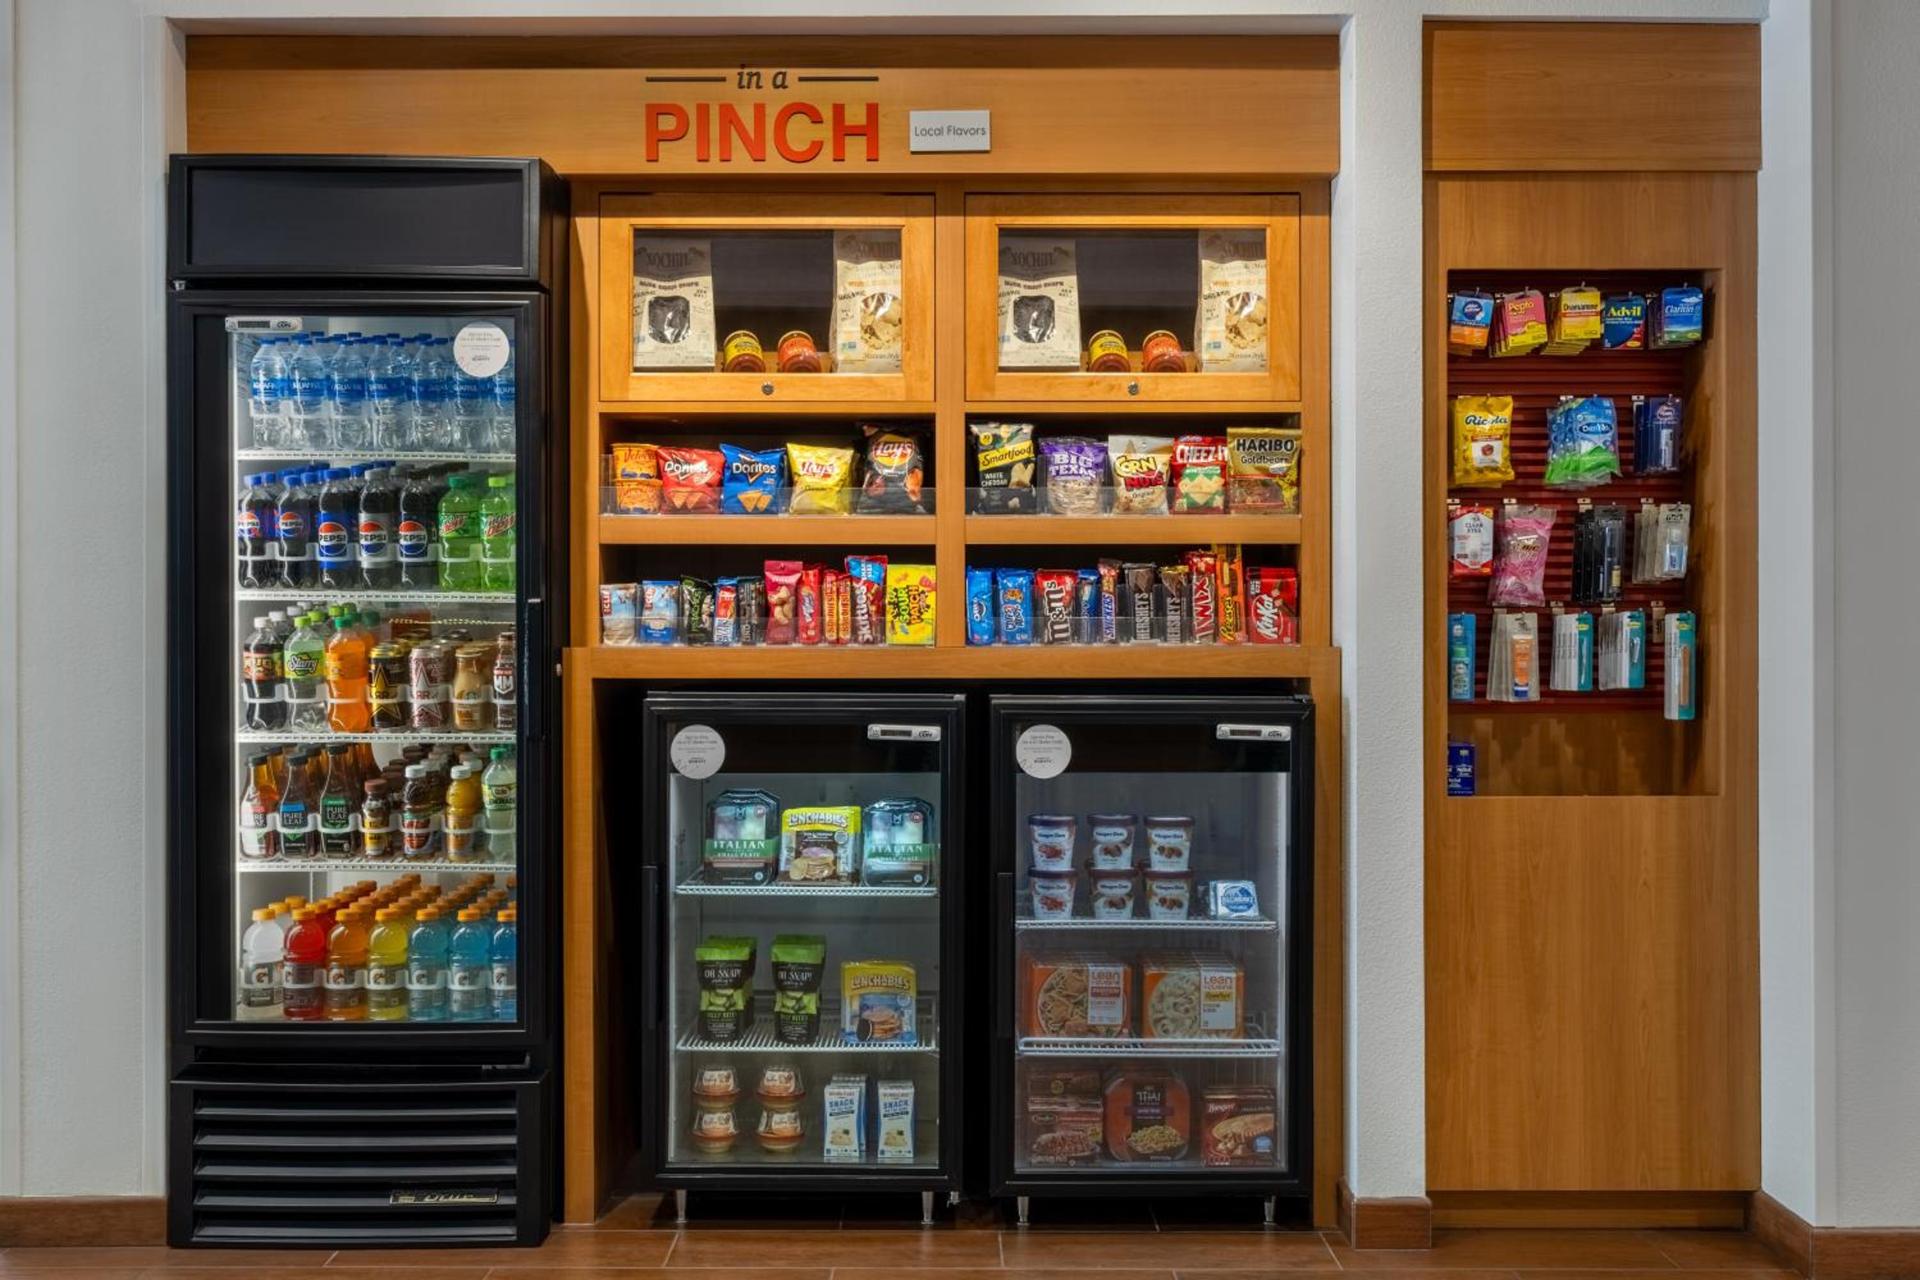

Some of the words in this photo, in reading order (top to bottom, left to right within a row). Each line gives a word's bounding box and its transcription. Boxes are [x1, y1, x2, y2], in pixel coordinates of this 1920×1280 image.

[737, 64, 763, 89] in
[772, 70, 788, 89] a
[645, 102, 879, 163] PINCH
[914, 125, 944, 138] Local
[946, 125, 987, 137] Flavors
[1509, 301, 1535, 313] Pepto
[1607, 306, 1641, 317] Advil
[1465, 415, 1510, 426] Ricola
[1236, 439, 1295, 452] HARIBO
[981, 446, 1032, 466] Smartfood
[1054, 452, 1094, 468] BIG
[1240, 455, 1290, 465] Goldbears
[732, 462, 777, 474] Doritos
[1049, 465, 1097, 479] TEXAS
[1114, 455, 1158, 476] CORN
[319, 533, 347, 542] PEPSI
[360, 533, 386, 542] PEPSI
[898, 588, 909, 623] SOUR
[909, 585, 921, 624] PATCH
[1195, 576, 1214, 638] TWIX
[855, 585, 873, 642] Skittles
[1103, 595, 1116, 638] SNICKERS
[1135, 592, 1149, 640] HERSHEY'S
[290, 656, 317, 671] Starry
[788, 811, 847, 827] LUNCHABLES
[714, 840, 766, 849] ITALIAN
[871, 845, 923, 853] ITALIAN
[704, 969, 715, 978] OH
[1202, 975, 1232, 985] Lean
[851, 975, 912, 990] LUNCHABLES
[1137, 1090, 1161, 1102] THAI
[829, 1099, 855, 1108] SNACK
[883, 1100, 909, 1108] SNACK
